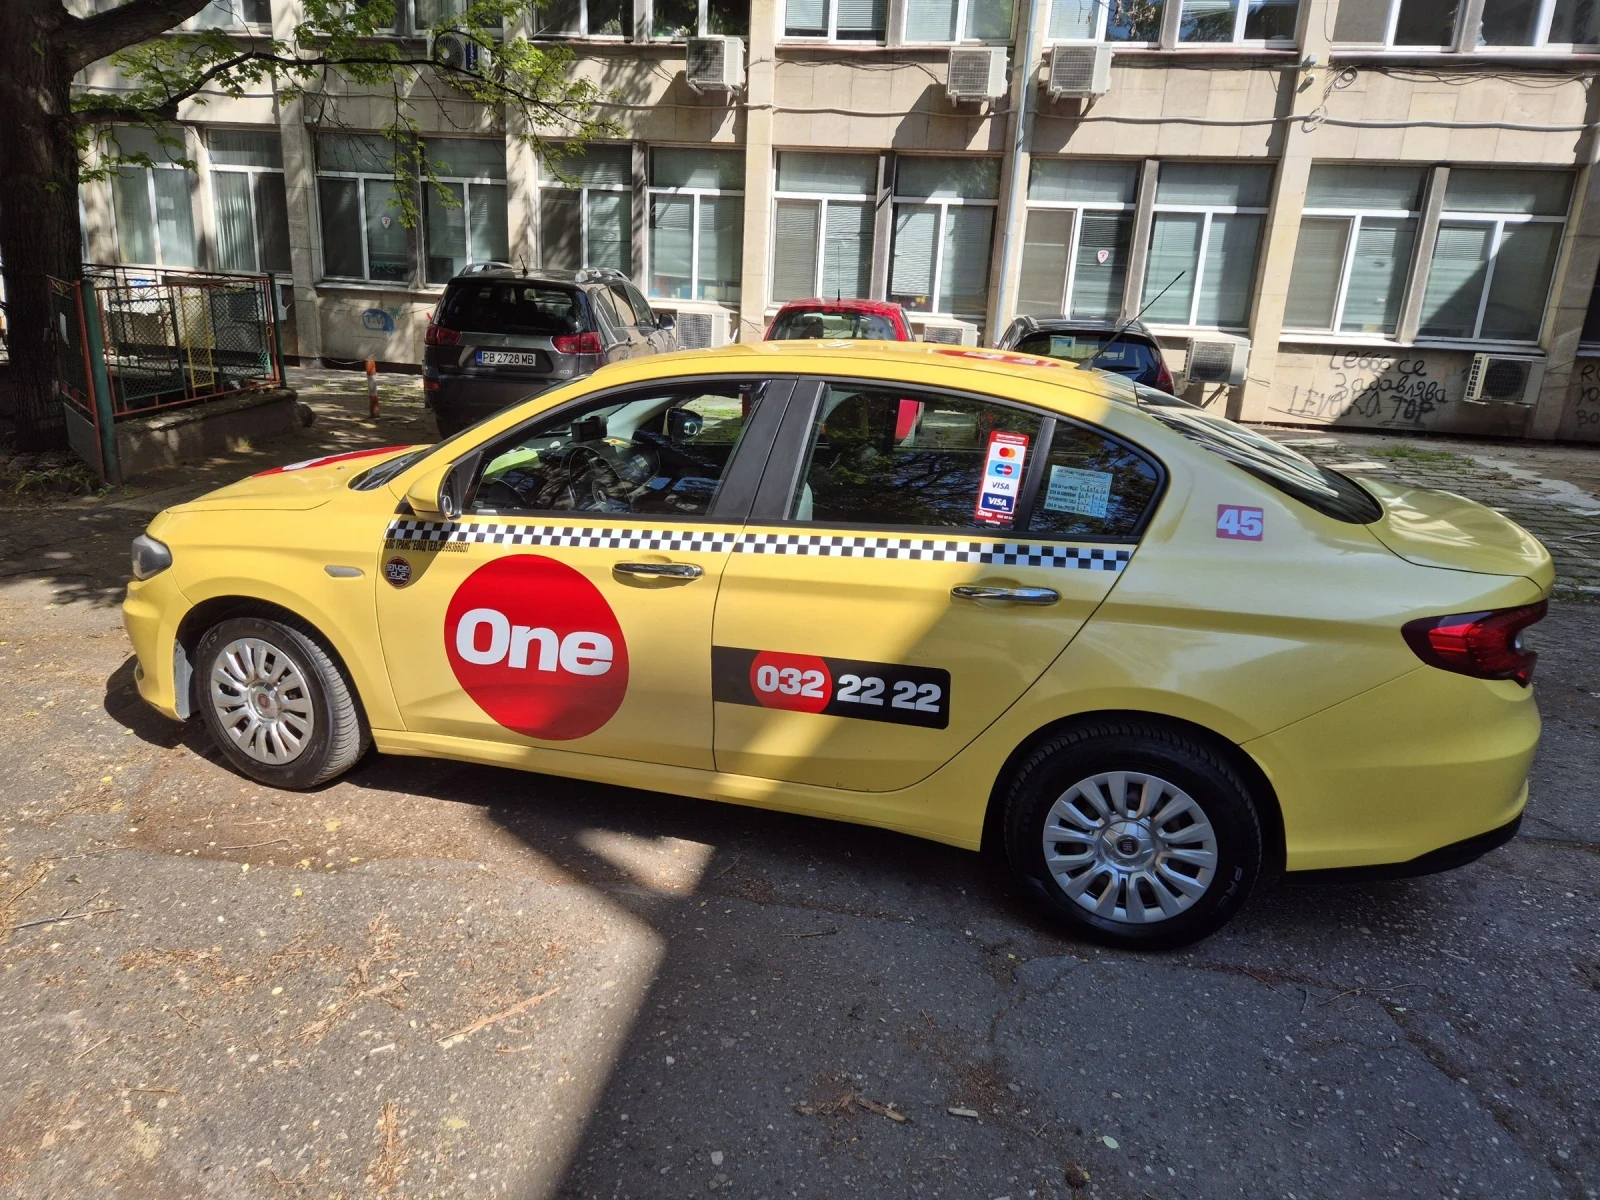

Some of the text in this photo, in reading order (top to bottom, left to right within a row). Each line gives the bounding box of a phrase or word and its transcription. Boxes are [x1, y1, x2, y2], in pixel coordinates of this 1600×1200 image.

[483, 352, 534, 364] PB 2728 MB
[992, 481, 1010, 490] VISA
[988, 496, 1007, 506] VISA
[1217, 508, 1263, 537] 45
[456, 608, 613, 676] One
[757, 665, 942, 713] 032 22 22
